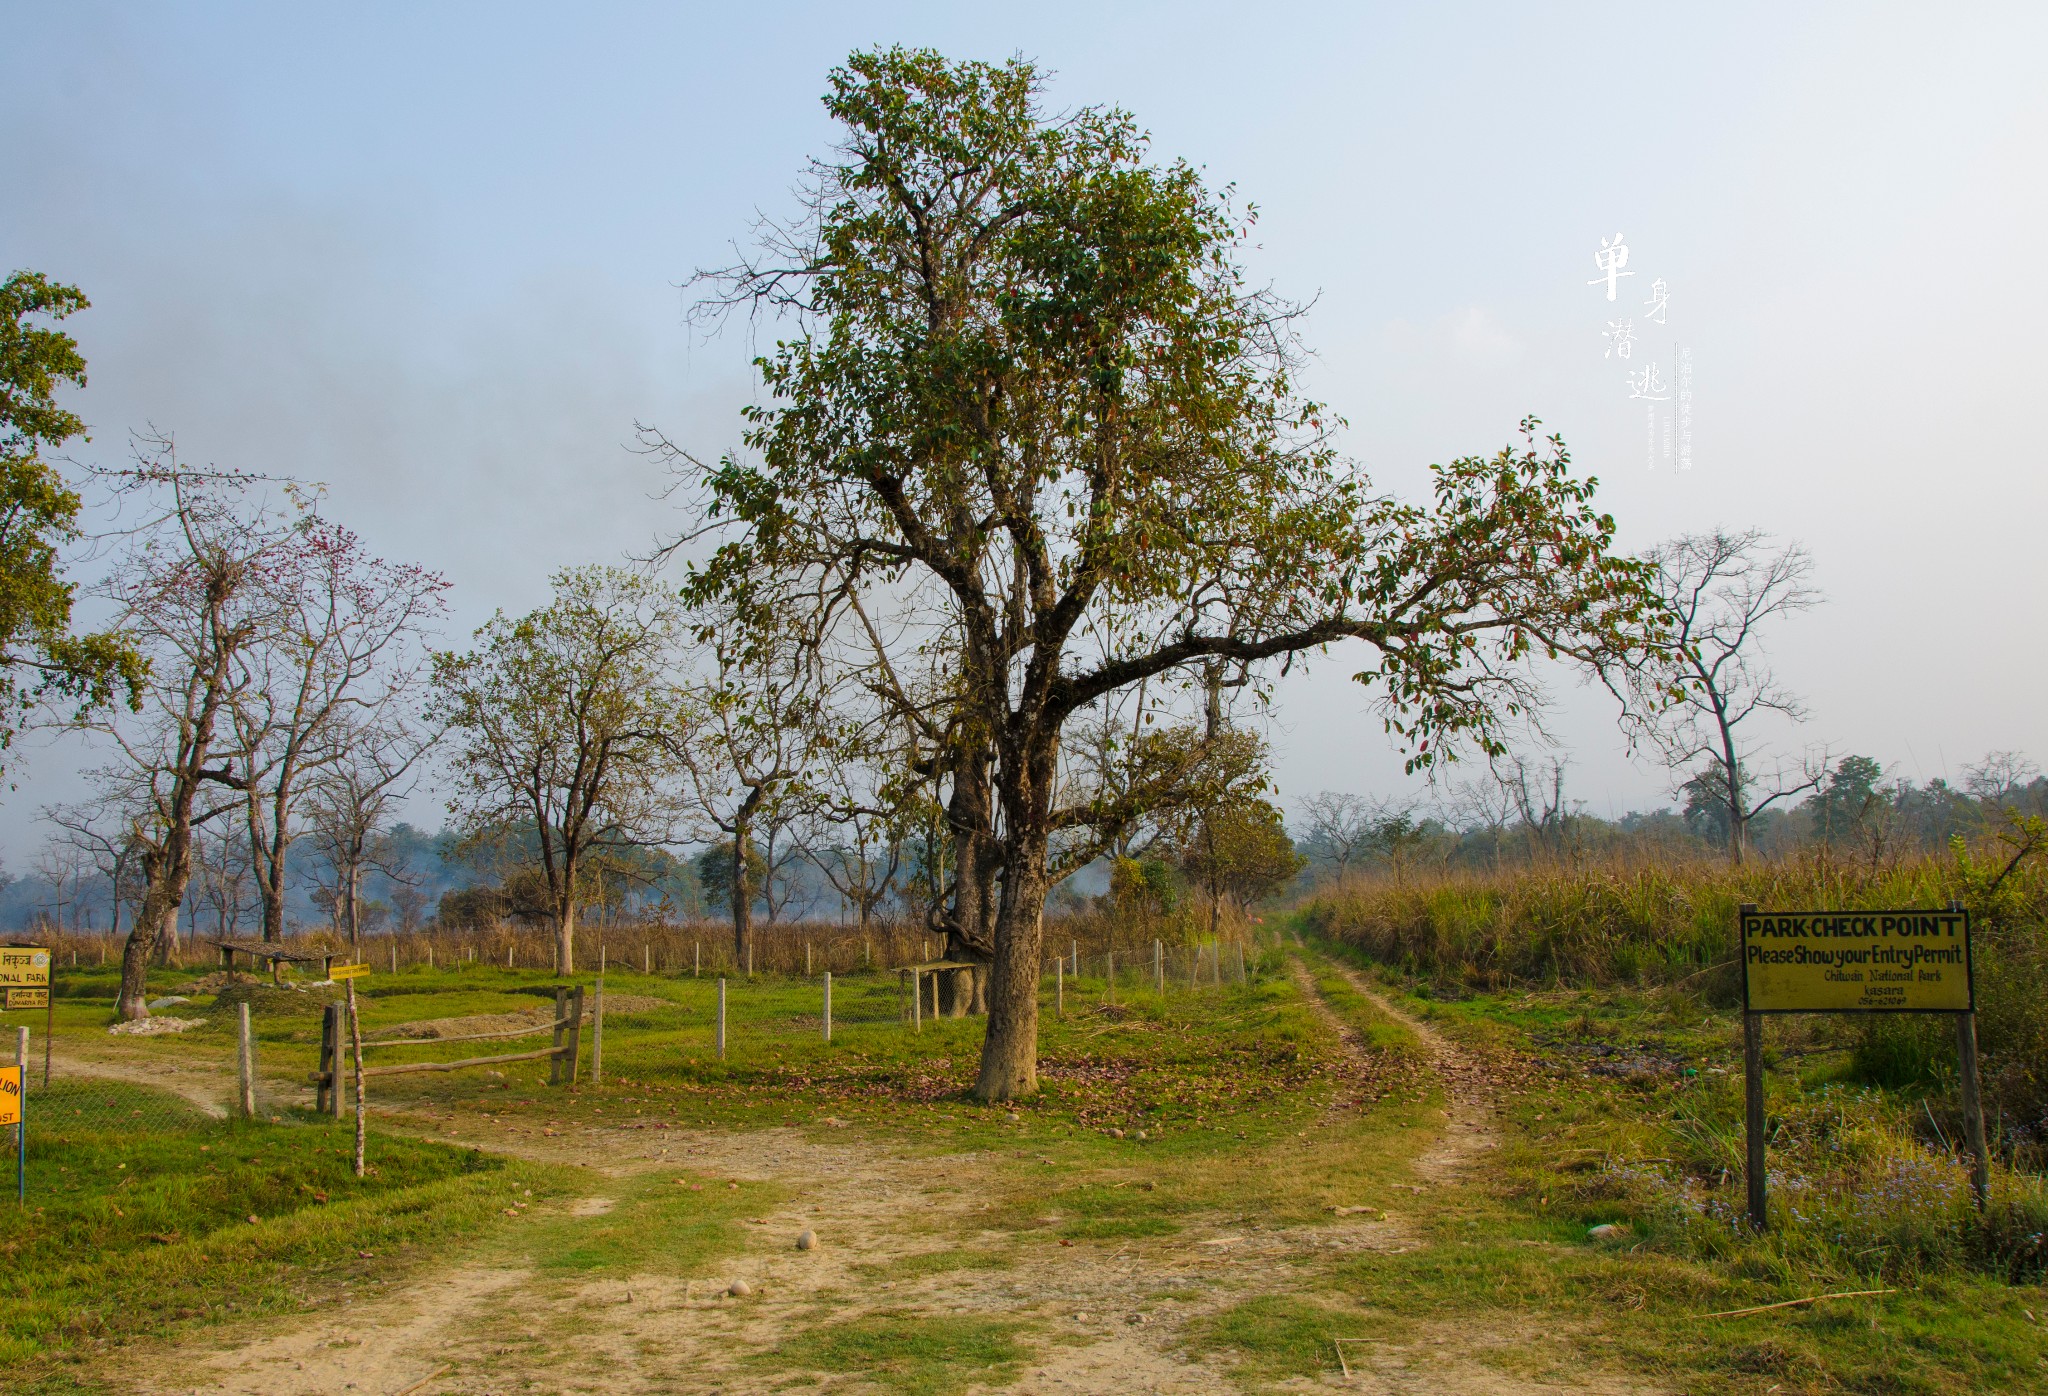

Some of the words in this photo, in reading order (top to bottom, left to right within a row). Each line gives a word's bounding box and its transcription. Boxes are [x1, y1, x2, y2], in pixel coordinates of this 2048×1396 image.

[1811, 917, 1878, 938] CHECK
[1882, 916, 1962, 937] POINT
[1747, 945, 1794, 964] Please
[1794, 944, 1834, 964] Show
[1834, 949, 1871, 968] your
[1872, 944, 1913, 969] Entry
[1914, 944, 1963, 964] Permit
[26, 973, 47, 982] PARK
[1869, 969, 1913, 982] National
[1918, 969, 1942, 982] Park
